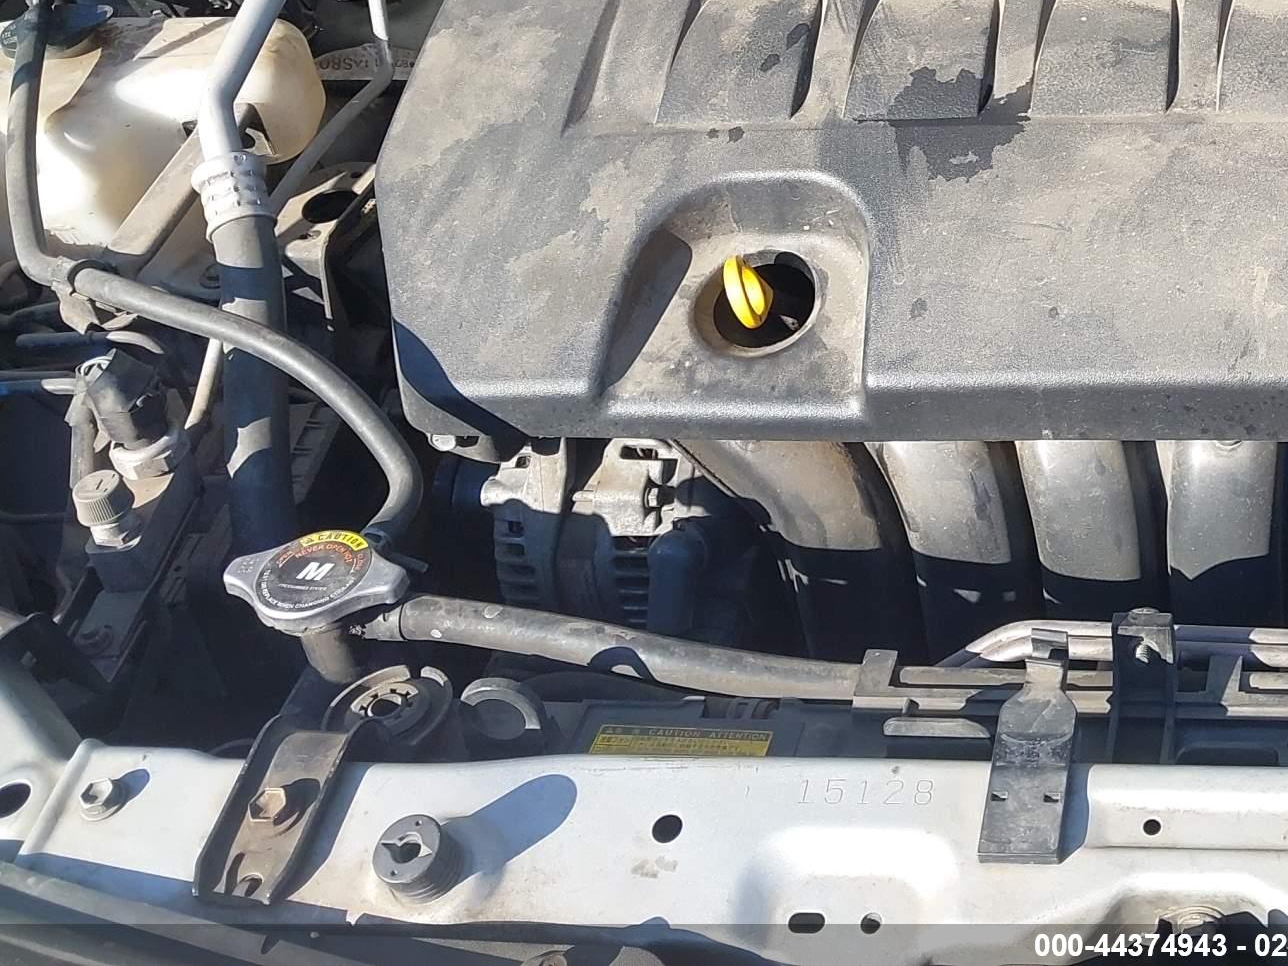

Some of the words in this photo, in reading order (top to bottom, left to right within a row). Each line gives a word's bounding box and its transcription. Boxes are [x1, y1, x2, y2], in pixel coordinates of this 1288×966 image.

[318, 533, 366, 548] CAUTION
[295, 544, 325, 558] NEVER
[295, 562, 335, 581] M
[649, 728, 701, 738] CAUTION
[709, 730, 768, 740] ATTENTION
[797, 779, 934, 805] 15128
